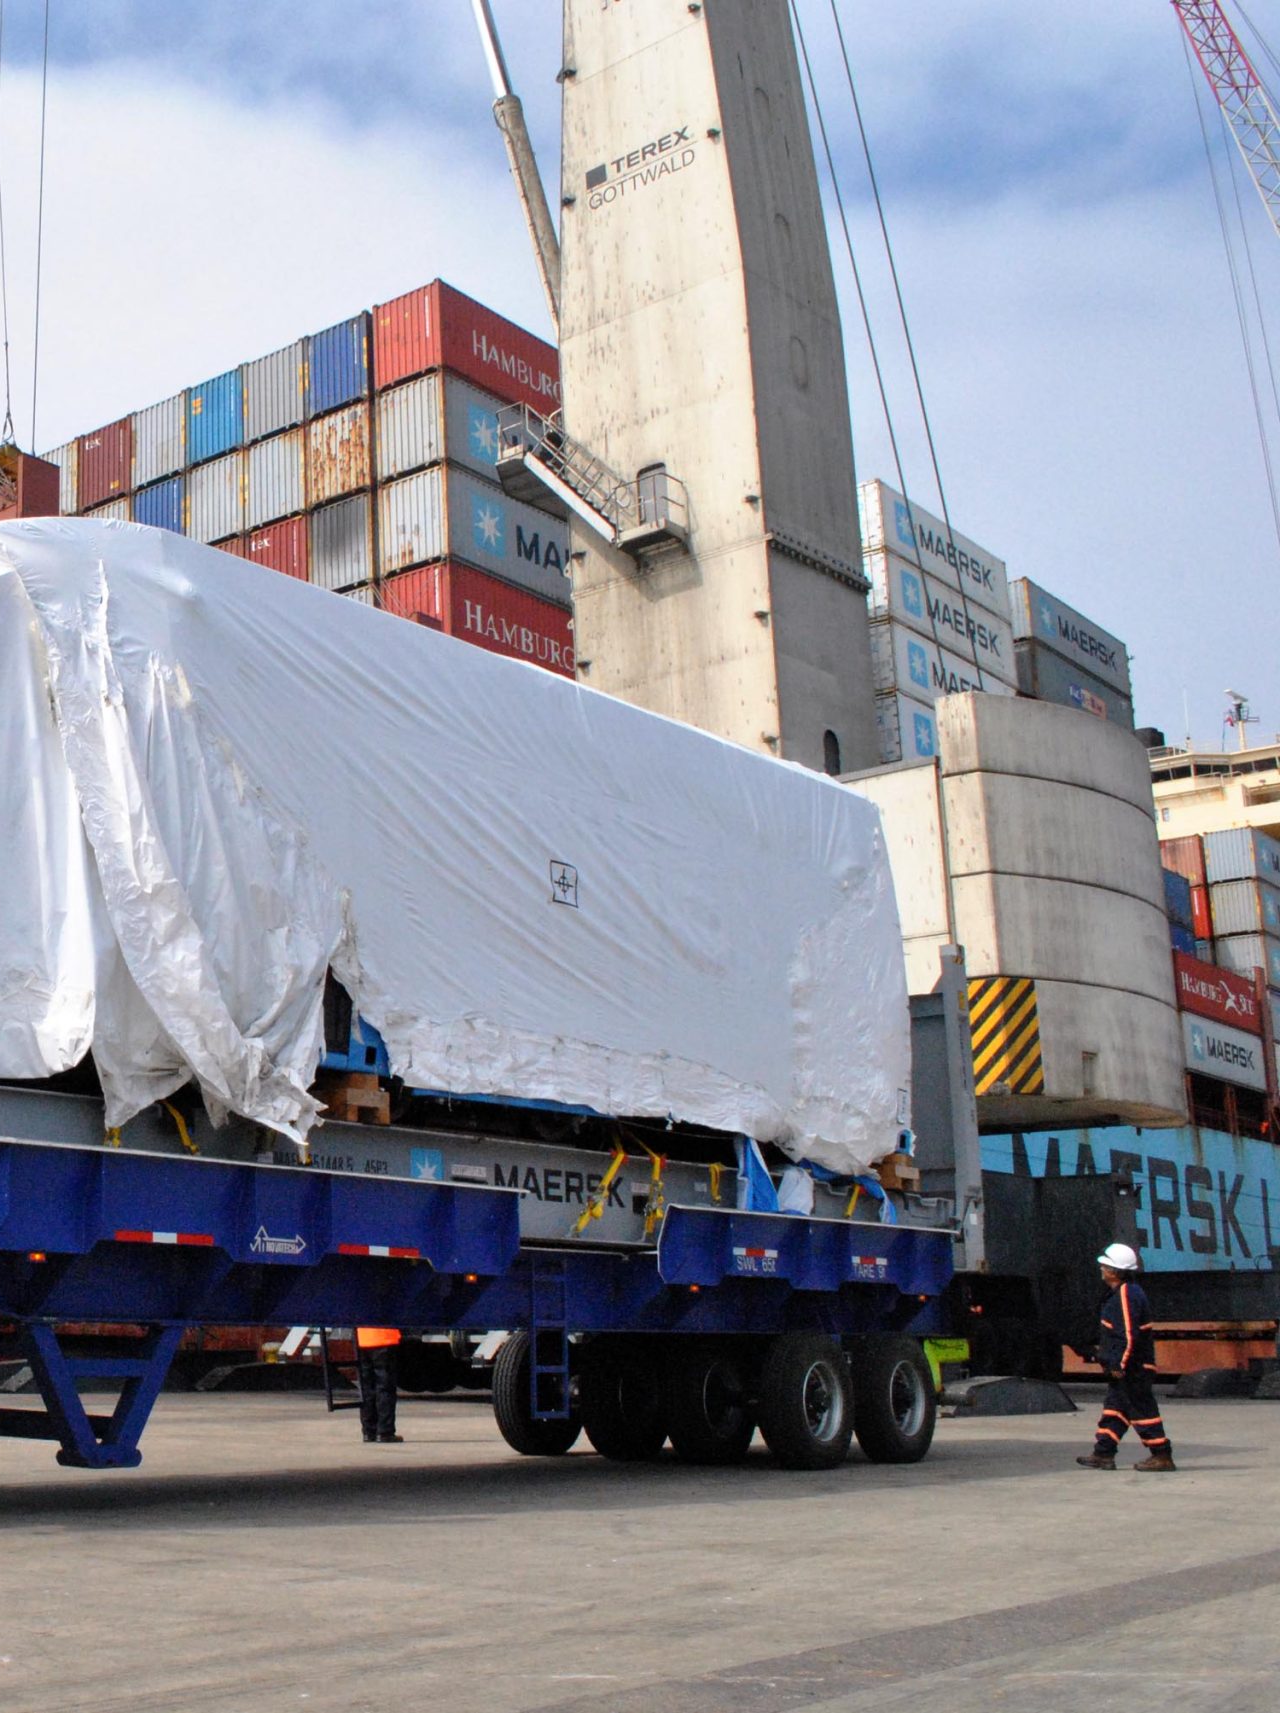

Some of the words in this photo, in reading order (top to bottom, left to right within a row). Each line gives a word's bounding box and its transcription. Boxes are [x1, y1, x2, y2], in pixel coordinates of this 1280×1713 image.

[610, 126, 690, 174] TEREX
[589, 149, 696, 210] GOTTWALD
[516, 525, 569, 577] MA
[919, 524, 993, 592] MAERSK
[926, 597, 1000, 658] MAERSK
[1058, 615, 1117, 672] MAERSK
[1206, 1036, 1255, 1070] MAERSK
[309, 1153, 343, 1171] 51448
[736, 1255, 758, 1271] SWL
[853, 1264, 875, 1278] TARE
